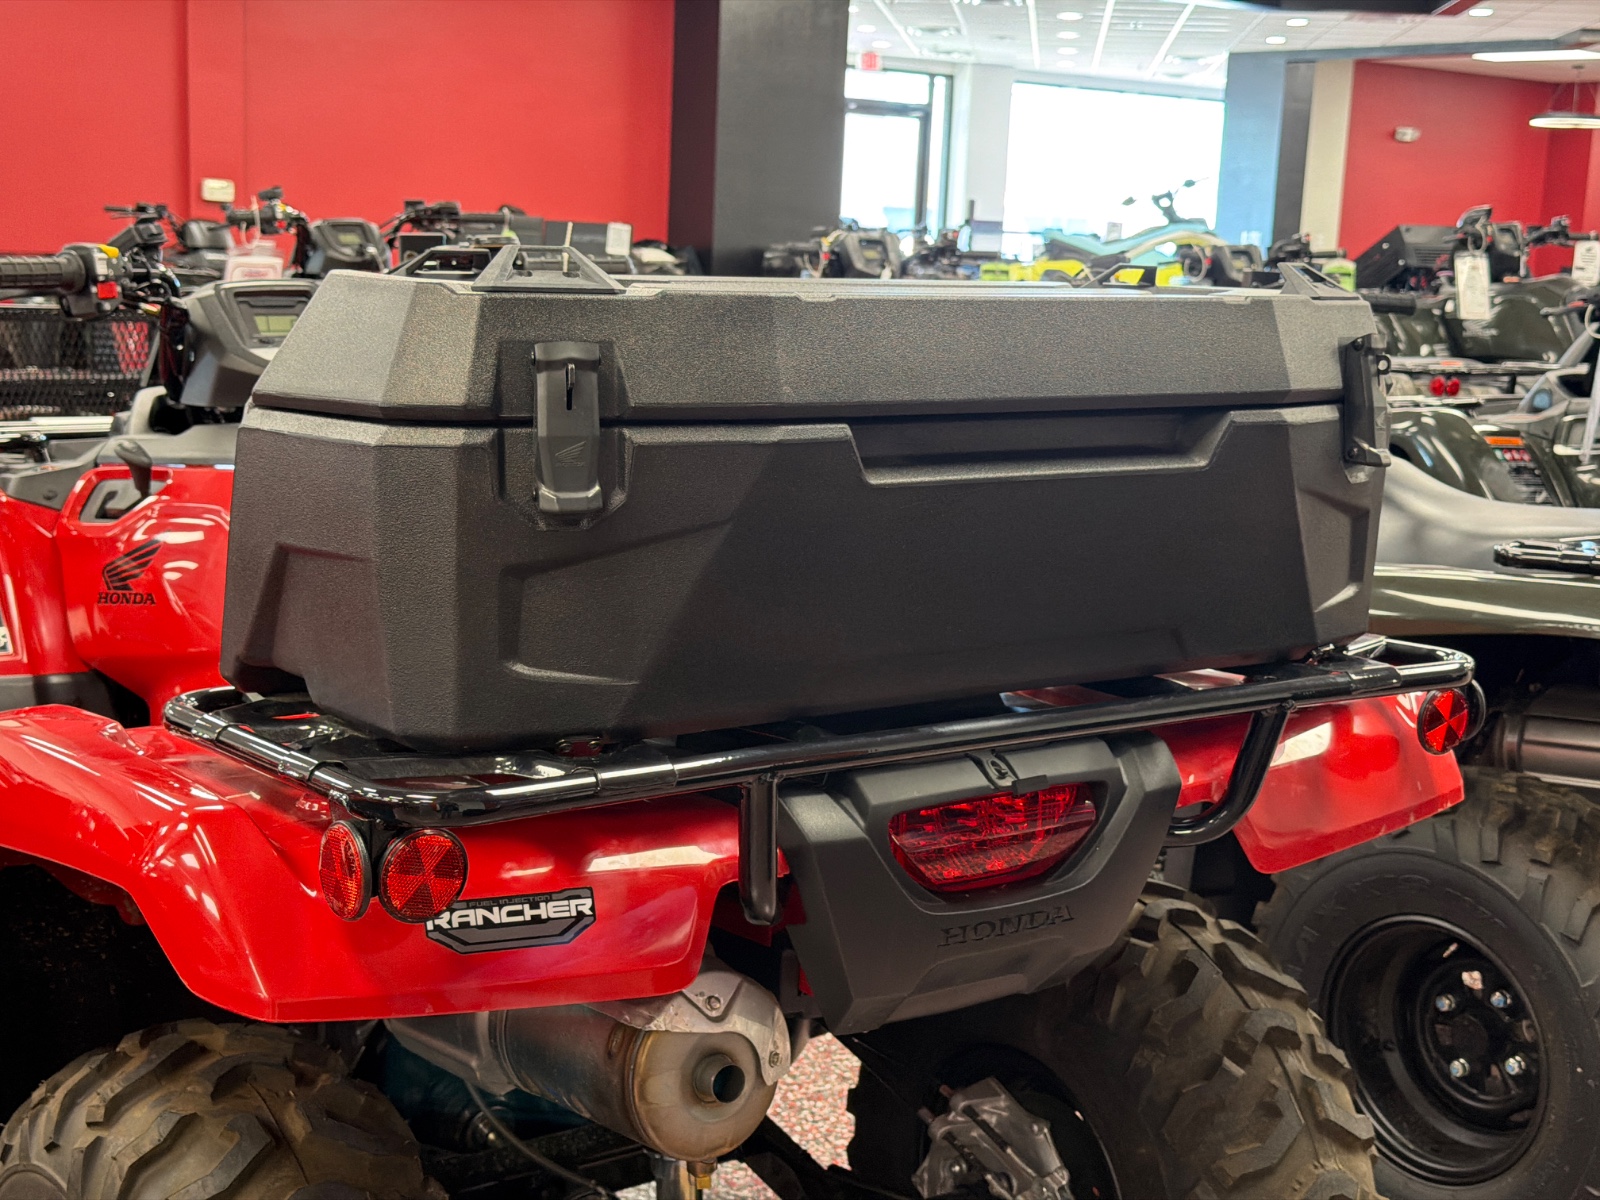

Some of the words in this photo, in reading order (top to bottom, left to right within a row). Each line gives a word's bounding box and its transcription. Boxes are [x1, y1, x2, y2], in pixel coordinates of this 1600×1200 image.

[97, 592, 156, 605] HONDA
[468, 899, 497, 908] FUEL
[499, 895, 550, 906] INJECTION
[426, 898, 594, 931] RANCHER
[936, 905, 1075, 948] HONDA
